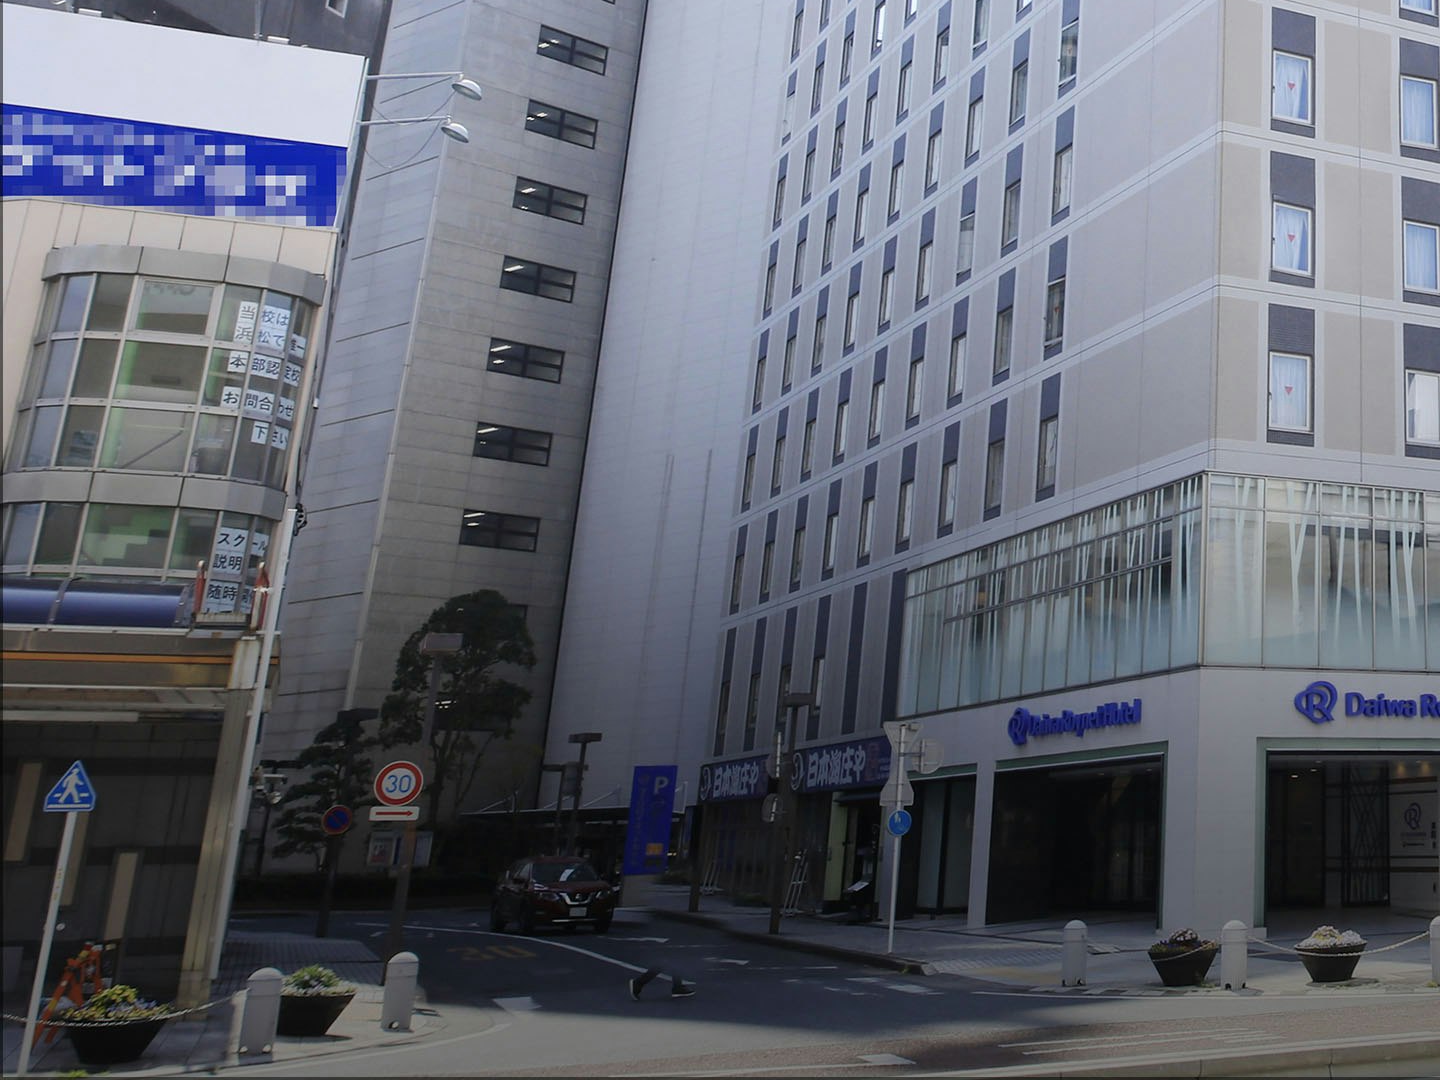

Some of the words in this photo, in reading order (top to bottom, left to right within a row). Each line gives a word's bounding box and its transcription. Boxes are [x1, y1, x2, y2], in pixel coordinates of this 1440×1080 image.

[1345, 692, 1417, 717] Daiwa
[385, 774, 412, 793] 30
[653, 775, 669, 796] P
